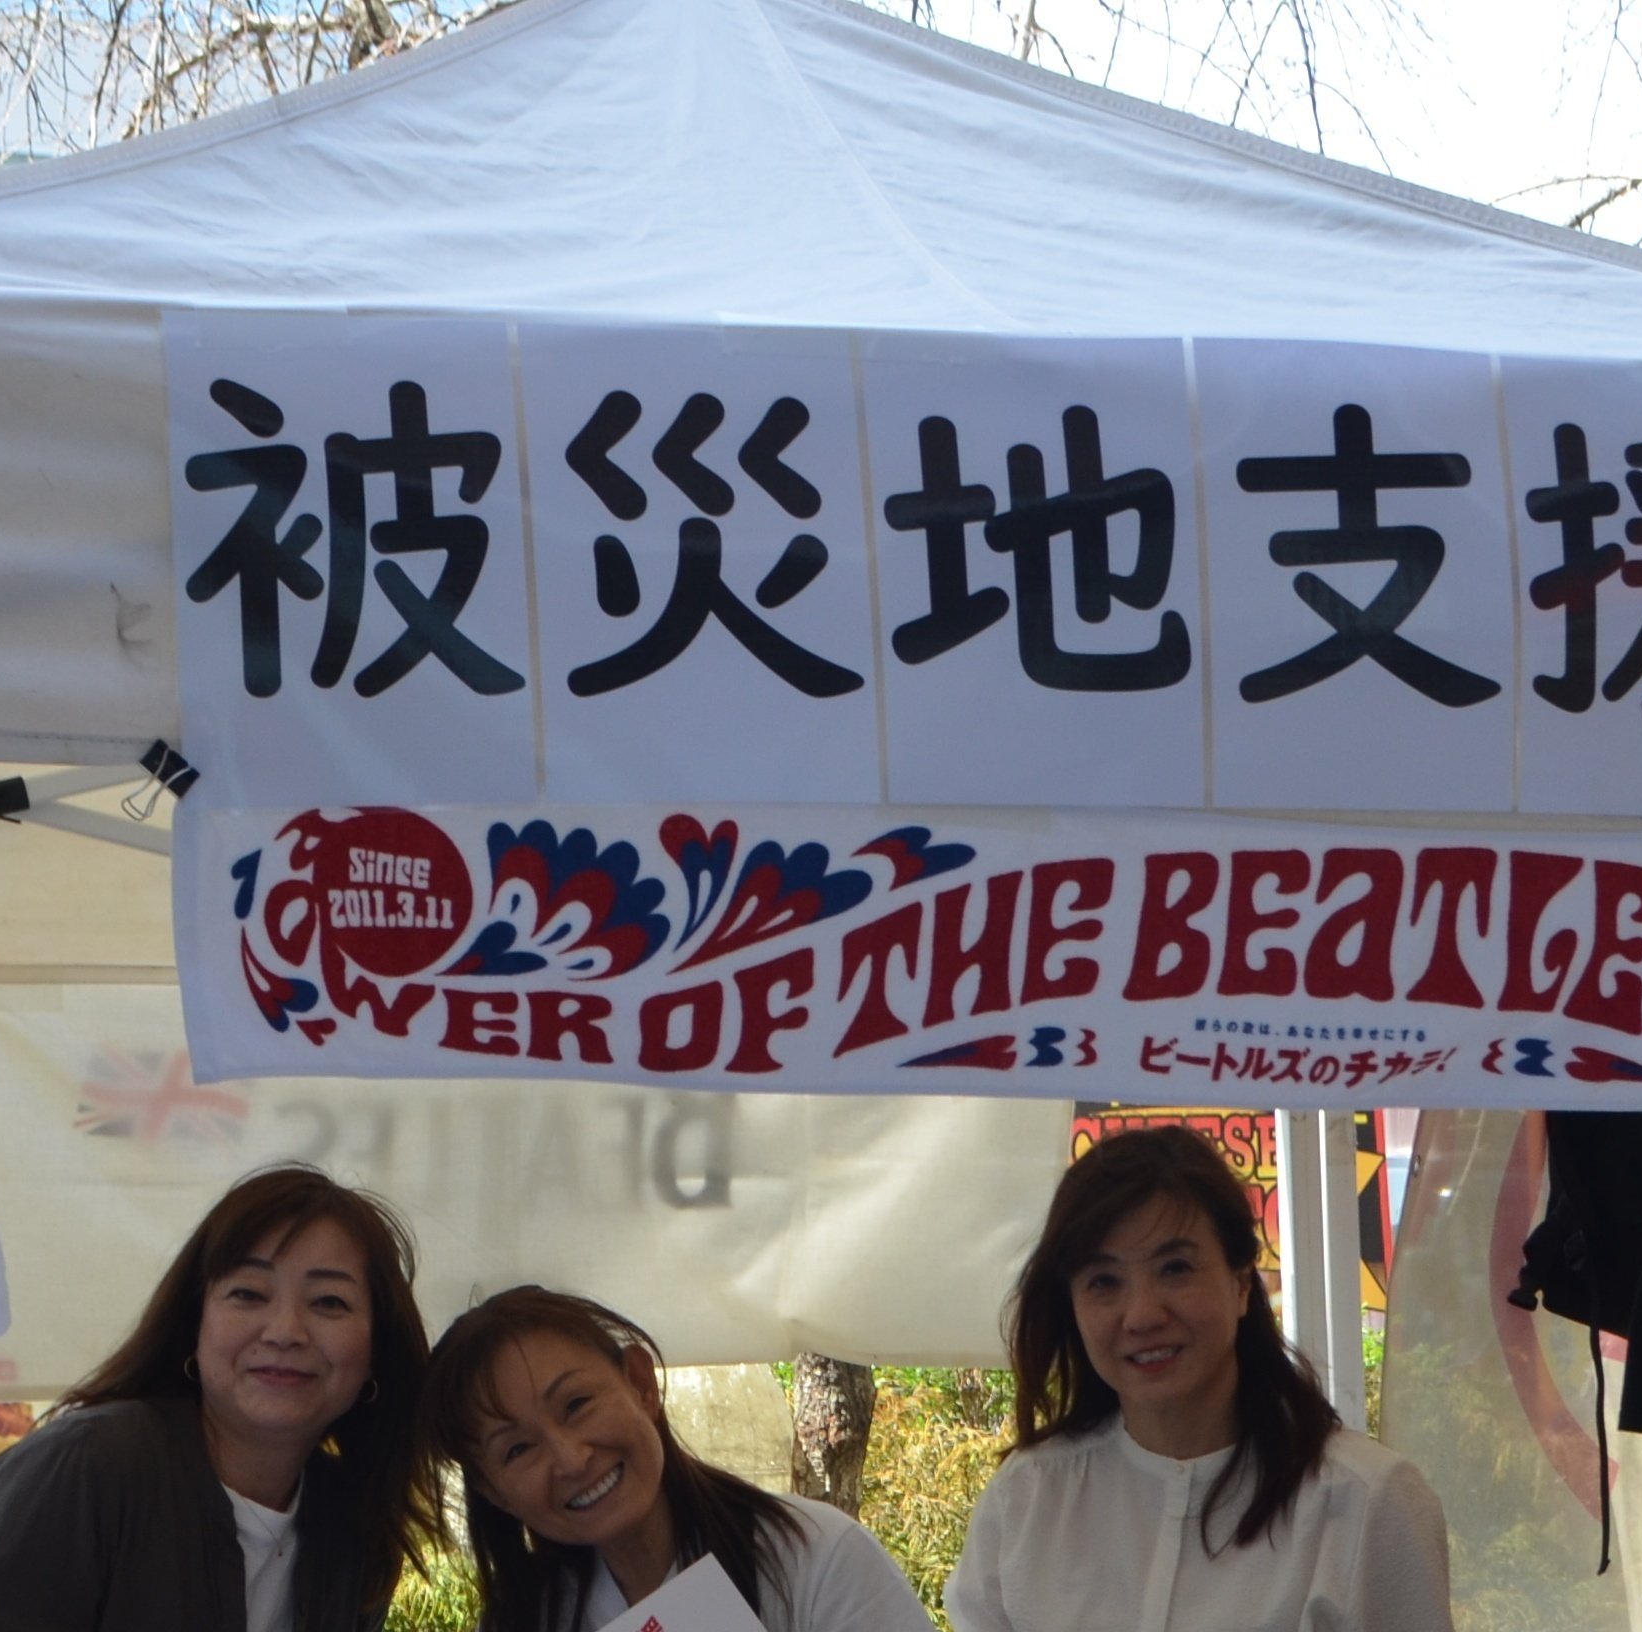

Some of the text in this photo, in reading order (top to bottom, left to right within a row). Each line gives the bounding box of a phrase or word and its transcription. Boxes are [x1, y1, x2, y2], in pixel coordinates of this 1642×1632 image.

[349, 847, 431, 888] Since
[328, 889, 454, 930] 2011.3.11
[639, 946, 814, 1075] OF
[832, 857, 1115, 1059] THE
